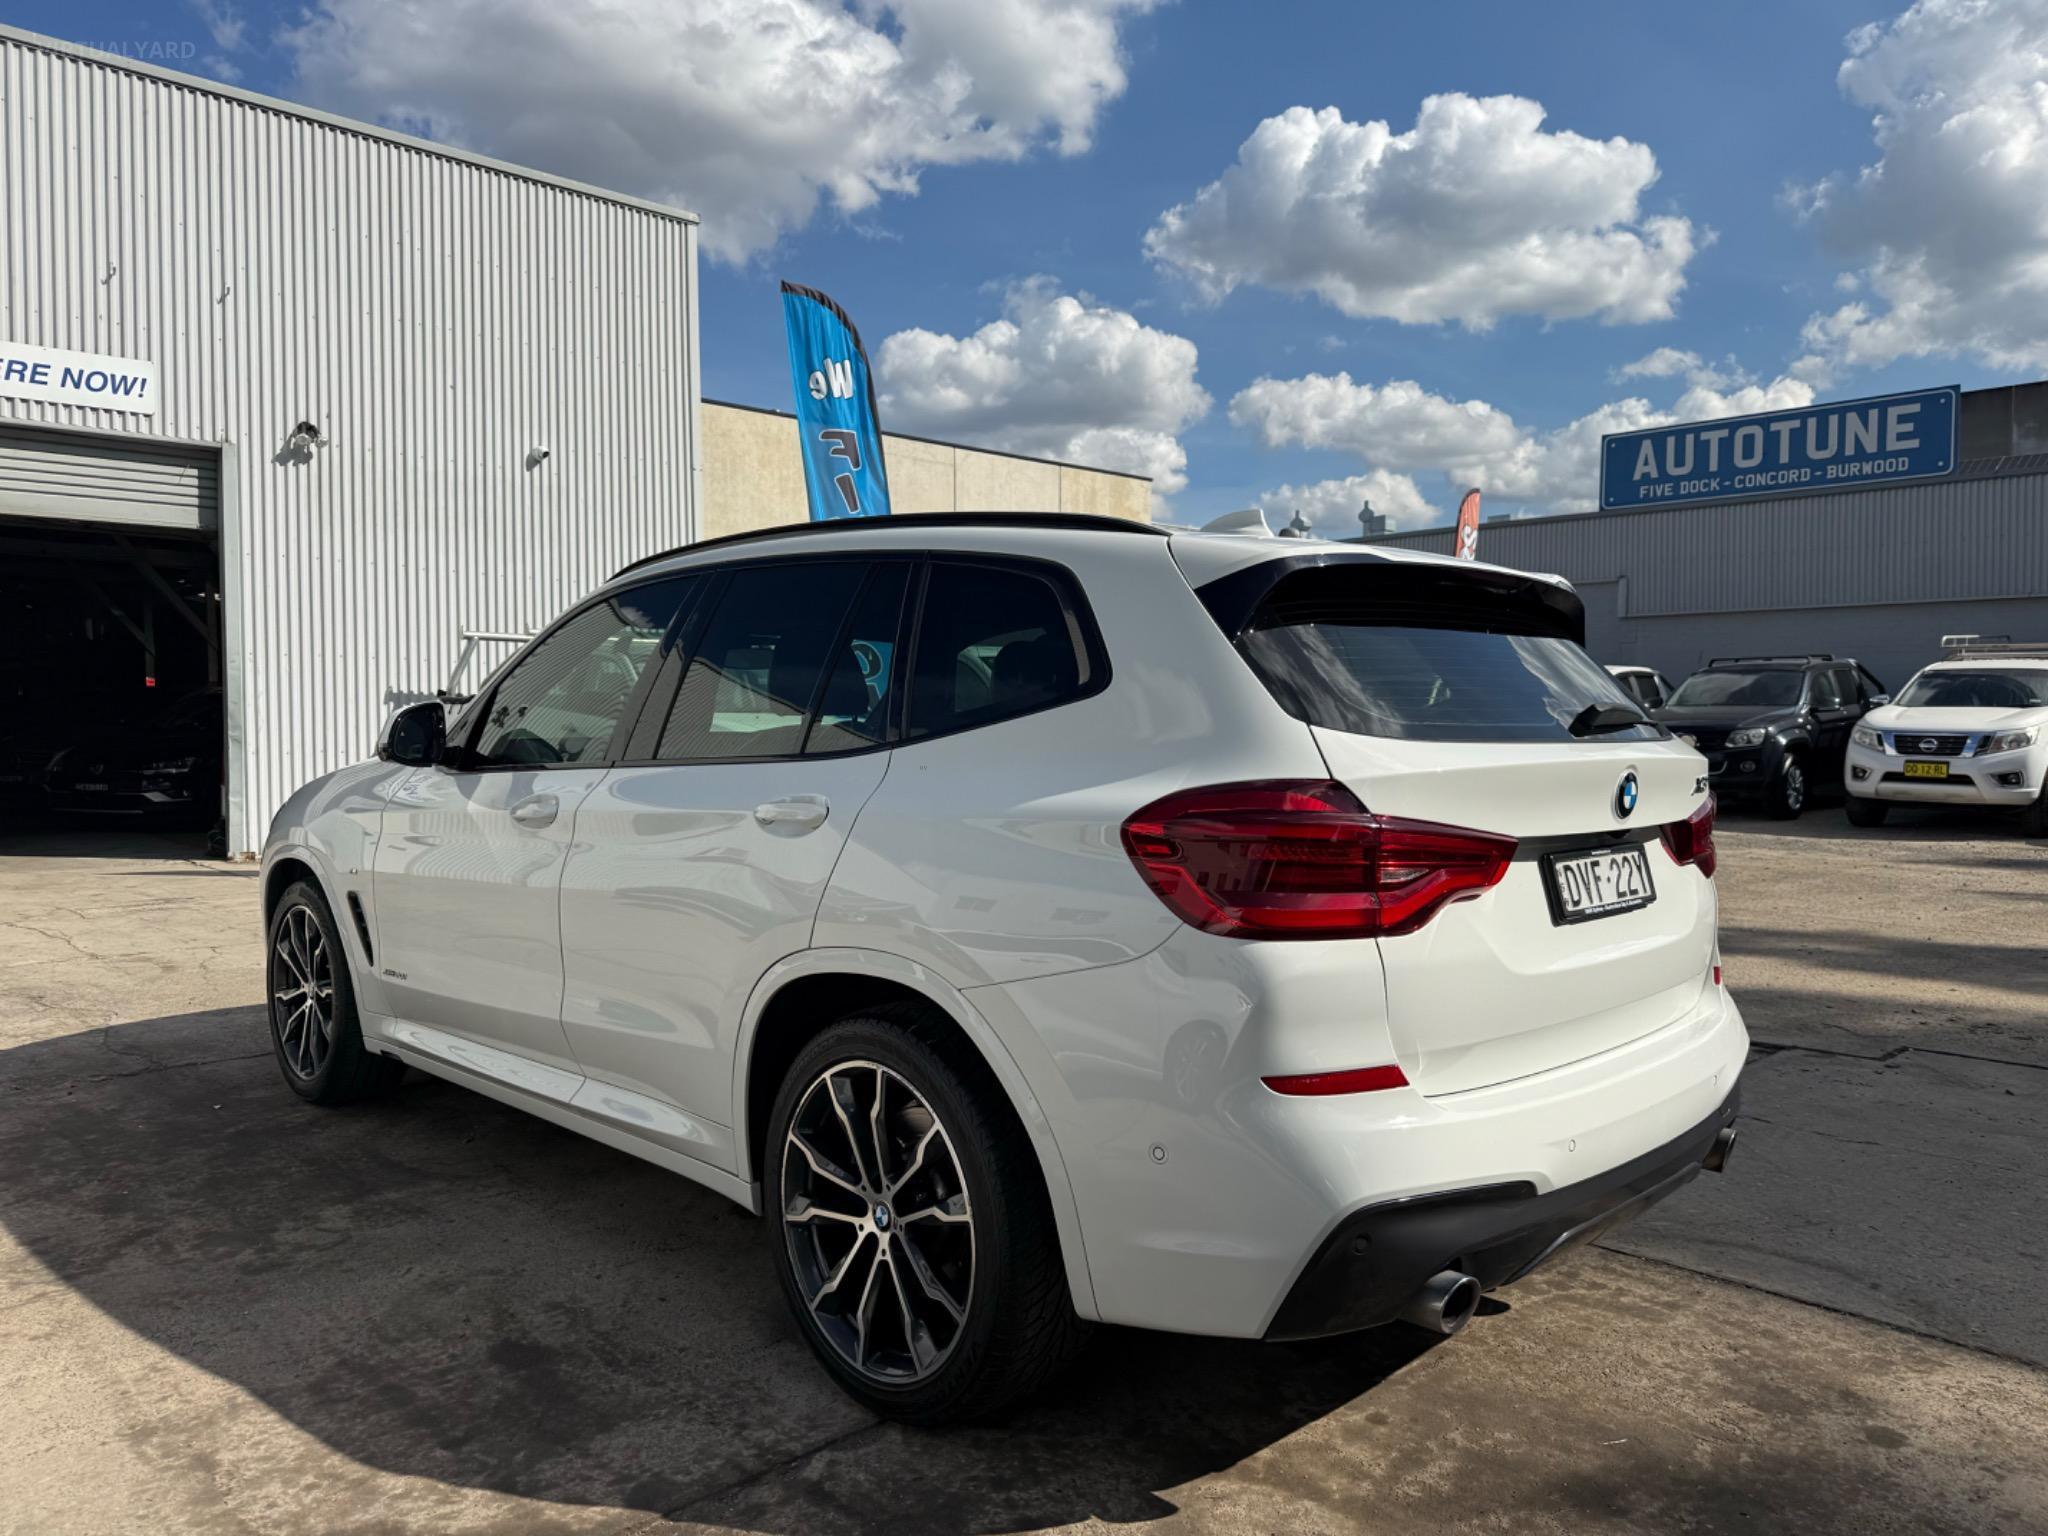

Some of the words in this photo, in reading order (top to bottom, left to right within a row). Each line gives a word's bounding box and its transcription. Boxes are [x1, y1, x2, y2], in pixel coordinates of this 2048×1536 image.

[0, 358, 51, 386] RE
[60, 366, 148, 398] NOW!
[1632, 402, 1921, 481] AUTOTUNE
[1640, 482, 1674, 498] FIVE
[1680, 478, 1720, 495] DOCK
[1734, 469, 1811, 489] CONCORD
[1826, 456, 1909, 480] BURWOOD
